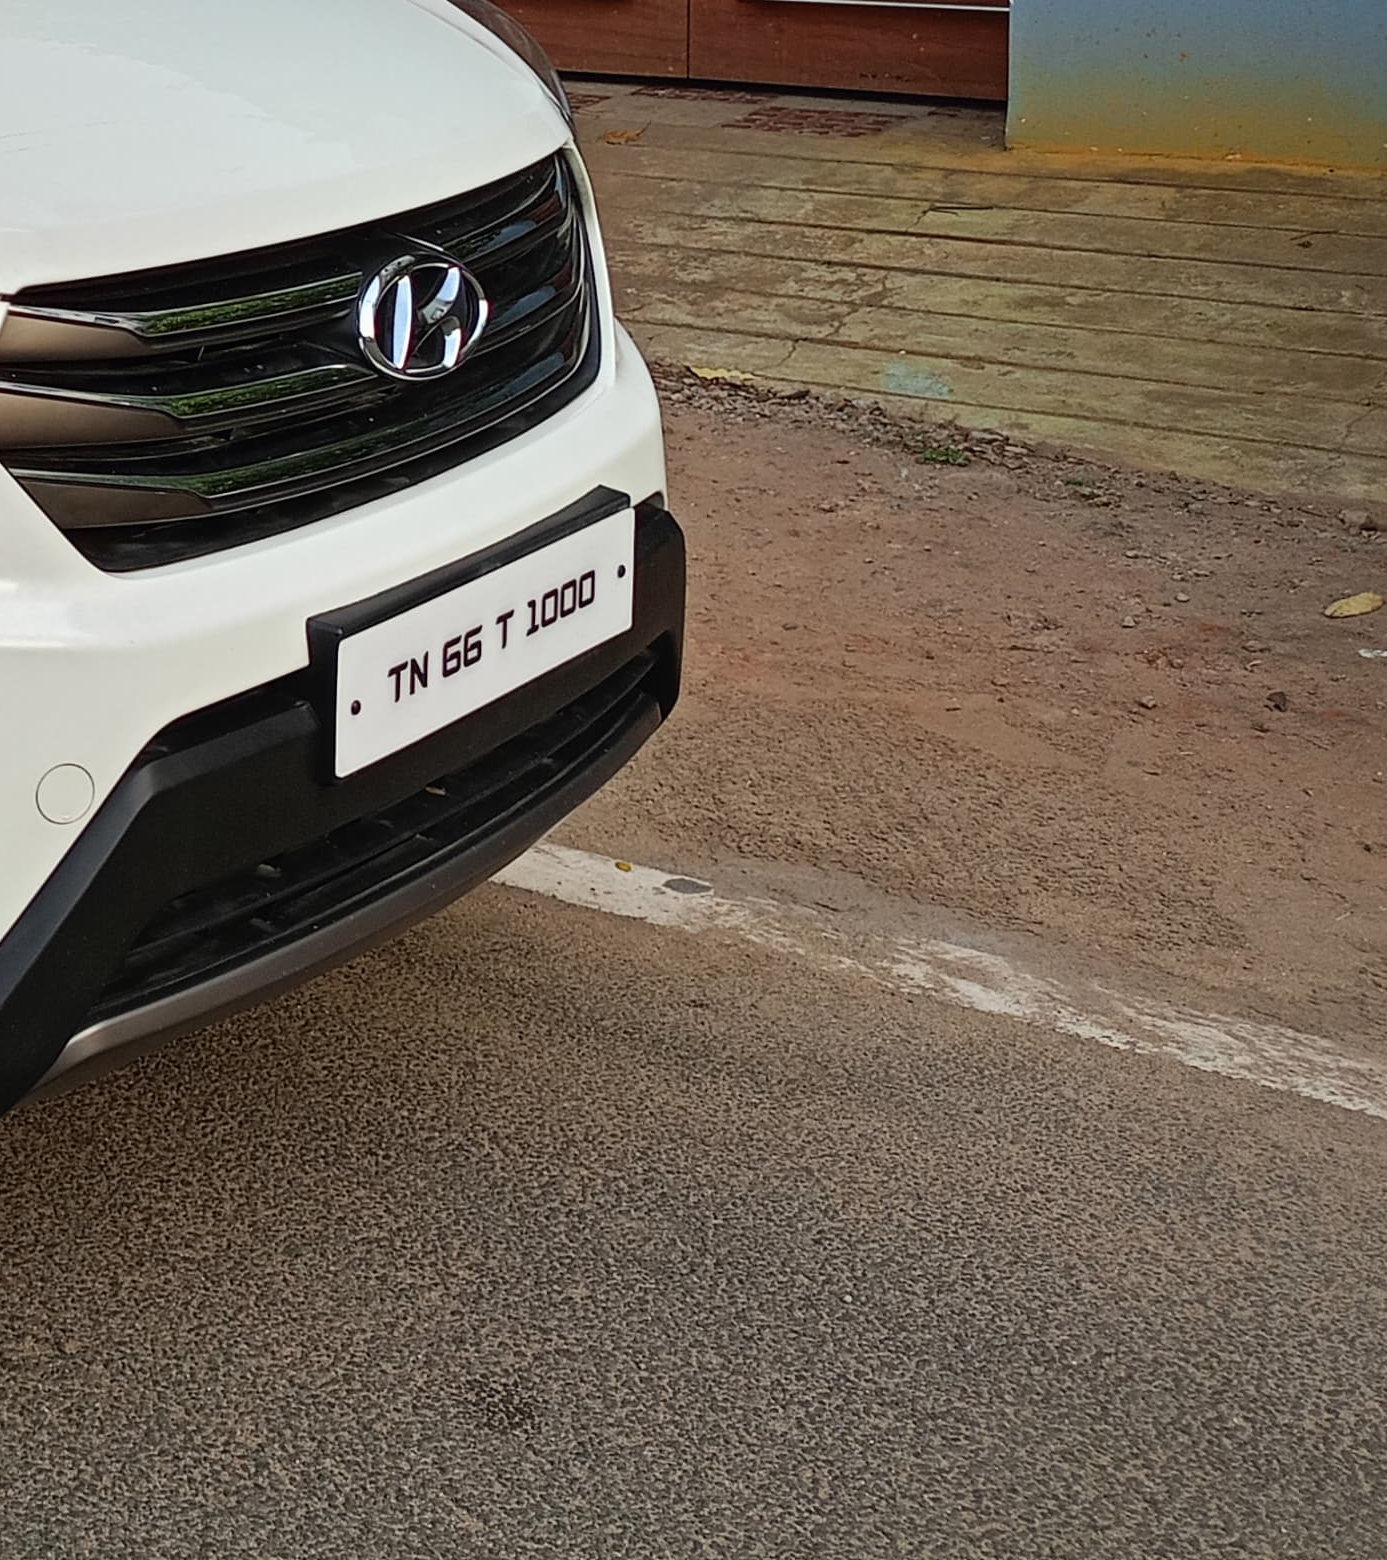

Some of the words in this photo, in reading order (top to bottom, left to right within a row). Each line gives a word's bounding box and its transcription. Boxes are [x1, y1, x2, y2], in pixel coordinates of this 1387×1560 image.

[387, 650, 429, 703] TN
[442, 624, 483, 678] 66
[495, 608, 515, 649] T
[526, 569, 596, 637] 1000
